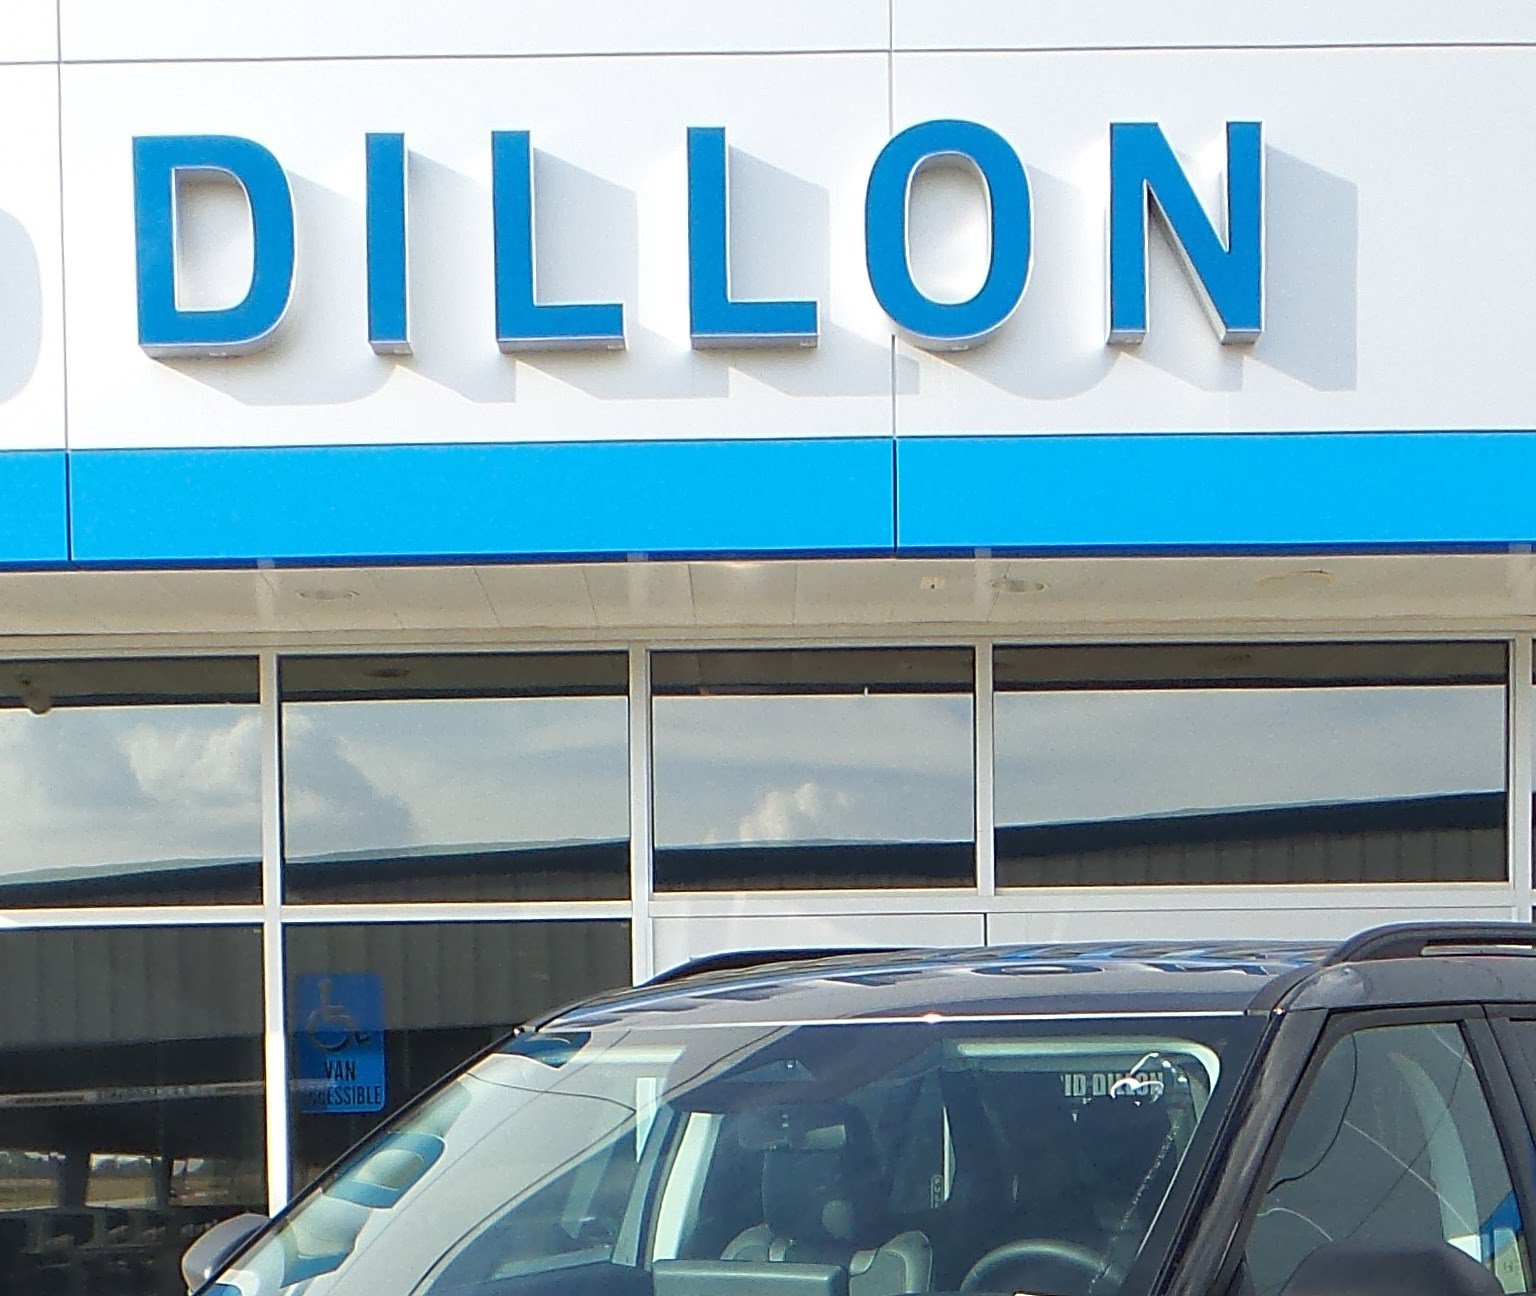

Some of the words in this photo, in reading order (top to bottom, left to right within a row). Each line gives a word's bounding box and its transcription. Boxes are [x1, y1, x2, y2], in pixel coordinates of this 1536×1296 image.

[132, 119, 1264, 352] DILLON
[324, 1058, 356, 1081] VAN
[1060, 1073, 1086, 1097] ID
